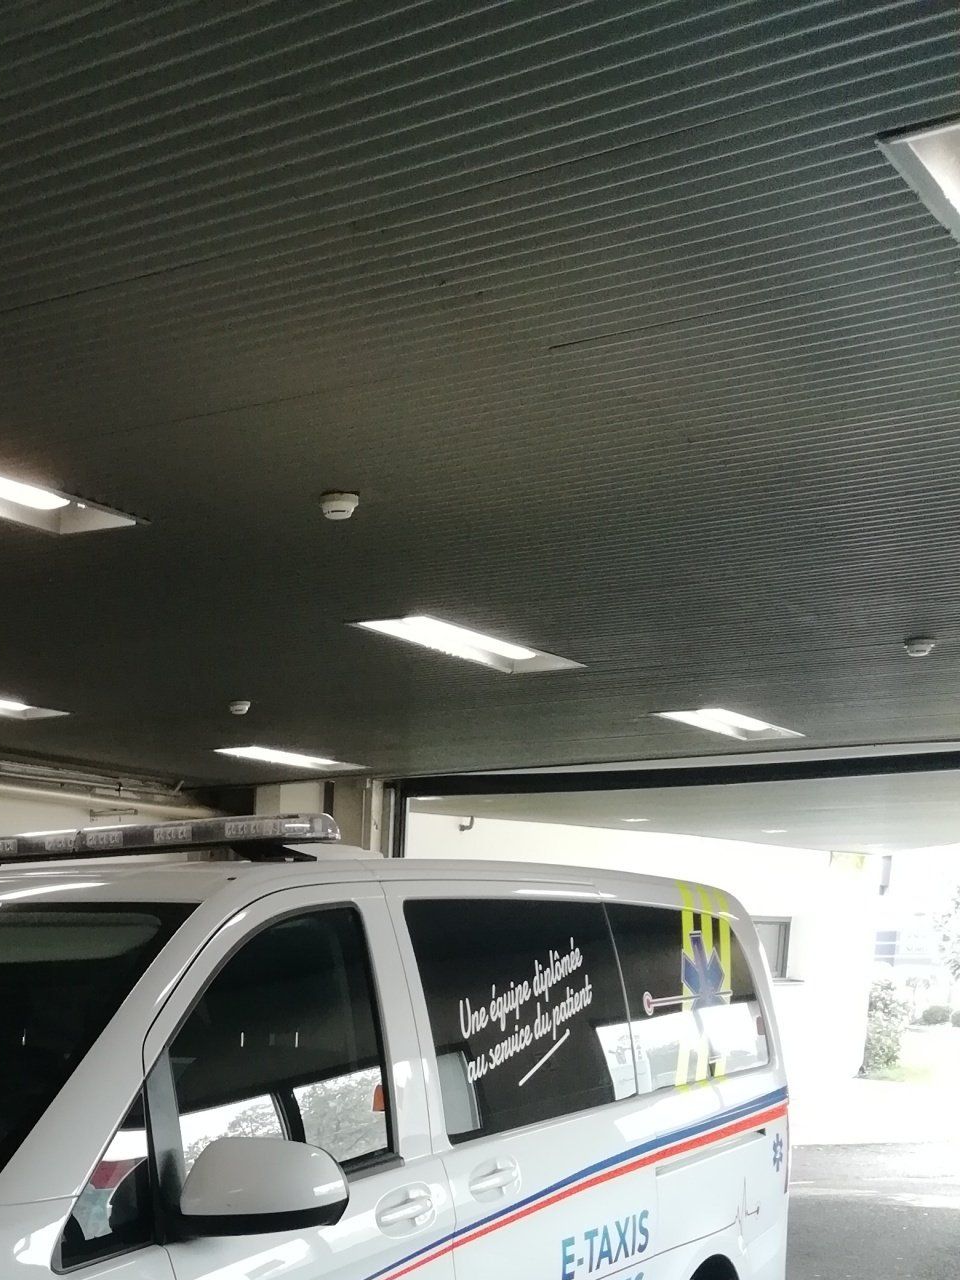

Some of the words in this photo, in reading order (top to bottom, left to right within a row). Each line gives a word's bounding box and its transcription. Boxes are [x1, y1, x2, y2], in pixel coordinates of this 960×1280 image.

[459, 998, 489, 1039] Une
[490, 981, 531, 1032] équipe
[533, 937, 583, 1002] diplômée
[467, 1054, 488, 1083] au
[489, 1025, 533, 1069] service
[534, 1002, 552, 1039] du
[553, 974, 592, 1040] patient
